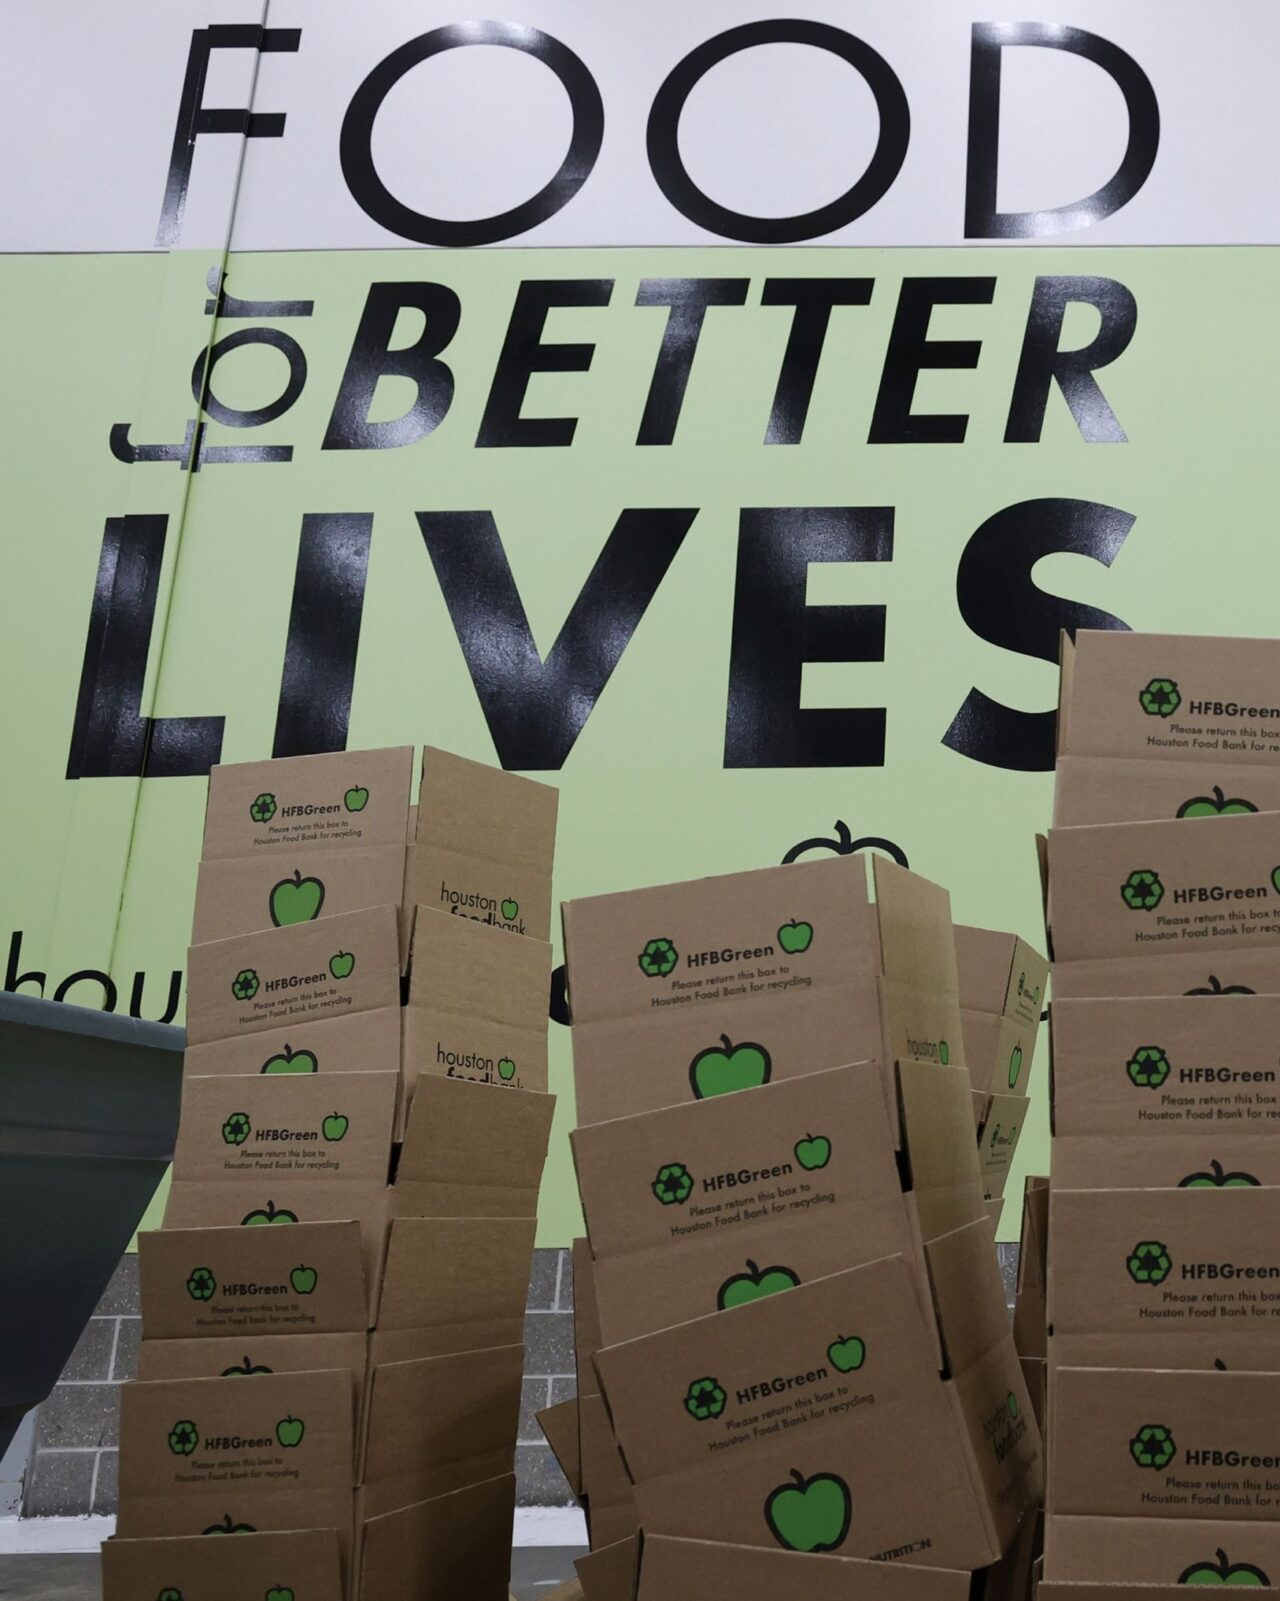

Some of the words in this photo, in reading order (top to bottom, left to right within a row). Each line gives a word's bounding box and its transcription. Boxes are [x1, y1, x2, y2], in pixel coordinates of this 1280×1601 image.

[155, 17, 1161, 247] FOOD
[109, 265, 316, 474] for
[320, 274, 1140, 452] BETTER
[65, 497, 1140, 781] LIVES
[1189, 700, 1280, 718] HFBGreen
[1169, 723, 1203, 735] Please
[1205, 727, 1237, 736] return
[1239, 726, 1257, 738] this
[1260, 727, 1280, 739] box
[1146, 735, 1189, 747] Houston
[1192, 737, 1219, 749] Food
[1222, 739, 1247, 750] Bank
[1250, 740, 1266, 751] for
[281, 804, 341, 818] HFBGreen
[440, 881, 497, 912] houston
[1173, 886, 1267, 904] HFBGreen
[1156, 915, 1190, 927] Please
[1193, 914, 1225, 924] return
[1228, 909, 1247, 921] this
[1249, 908, 1269, 920] box
[1134, 931, 1178, 942] Houston
[1181, 926, 1209, 939] Food
[1211, 924, 1238, 937] Bank
[1241, 923, 1256, 934] for
[686, 946, 774, 969] HFBGreen
[265, 972, 327, 993] HFBGreen
[671, 980, 703, 991] Please
[705, 975, 735, 986] return
[737, 969, 755, 981] this
[757, 967, 776, 978] box
[779, 965, 790, 975] to
[651, 995, 692, 1007] Houston
[694, 987, 720, 1001] Food
[722, 983, 747, 997] Bank
[749, 981, 764, 992] for
[767, 975, 812, 990] recycling
[436, 1042, 494, 1072] houston
[1179, 1067, 1275, 1083] HFBGreen
[1160, 1094, 1196, 1106] Please
[1198, 1095, 1231, 1105] return
[1234, 1092, 1253, 1104] this
[1255, 1092, 1276, 1105] box
[1138, 1109, 1182, 1120] Houston
[1185, 1108, 1213, 1120] Food
[1216, 1107, 1243, 1119] Bank
[1246, 1107, 1262, 1119] for
[255, 1128, 318, 1141] HFBGreen
[702, 1163, 793, 1193] HFBGreen
[689, 1204, 722, 1218] Please
[724, 1197, 755, 1210] return
[757, 1190, 776, 1202] this
[777, 1187, 797, 1198] box
[799, 1183, 811, 1193] to
[670, 1221, 712, 1236] Houston
[714, 1211, 741, 1227] Food
[743, 1205, 769, 1220] Bank
[771, 1202, 786, 1213] for
[789, 1192, 835, 1210] recycling
[1181, 1263, 1280, 1280] HFBGreen
[222, 1283, 288, 1297] HFBGreen
[1162, 1291, 1198, 1303] Please
[1201, 1292, 1235, 1303] return
[1238, 1289, 1257, 1302] this
[1260, 1289, 1280, 1302] box
[1139, 1307, 1185, 1318] Houston
[1188, 1305, 1217, 1317] Food
[1220, 1305, 1247, 1317] Bank
[1250, 1304, 1267, 1317] for
[735, 1367, 828, 1405] HFBGreen
[725, 1415, 759, 1432] Please
[761, 1404, 793, 1420] return
[794, 1397, 813, 1410] this
[813, 1390, 835, 1404] box
[836, 1386, 848, 1396] to
[708, 1433, 751, 1452] Houston
[752, 1420, 780, 1438] Food
[781, 1412, 808, 1429] Bank
[809, 1408, 825, 1420] for
[828, 1393, 875, 1414] recycling
[204, 1436, 273, 1451] HFBGreen
[1165, 1476, 1202, 1489] Please
[1205, 1479, 1239, 1490] return
[1242, 1478, 1262, 1491] this
[1141, 1491, 1188, 1504] Houston
[1191, 1492, 1220, 1505] Food
[1223, 1493, 1251, 1505] Bank
[1255, 1493, 1272, 1506] for
